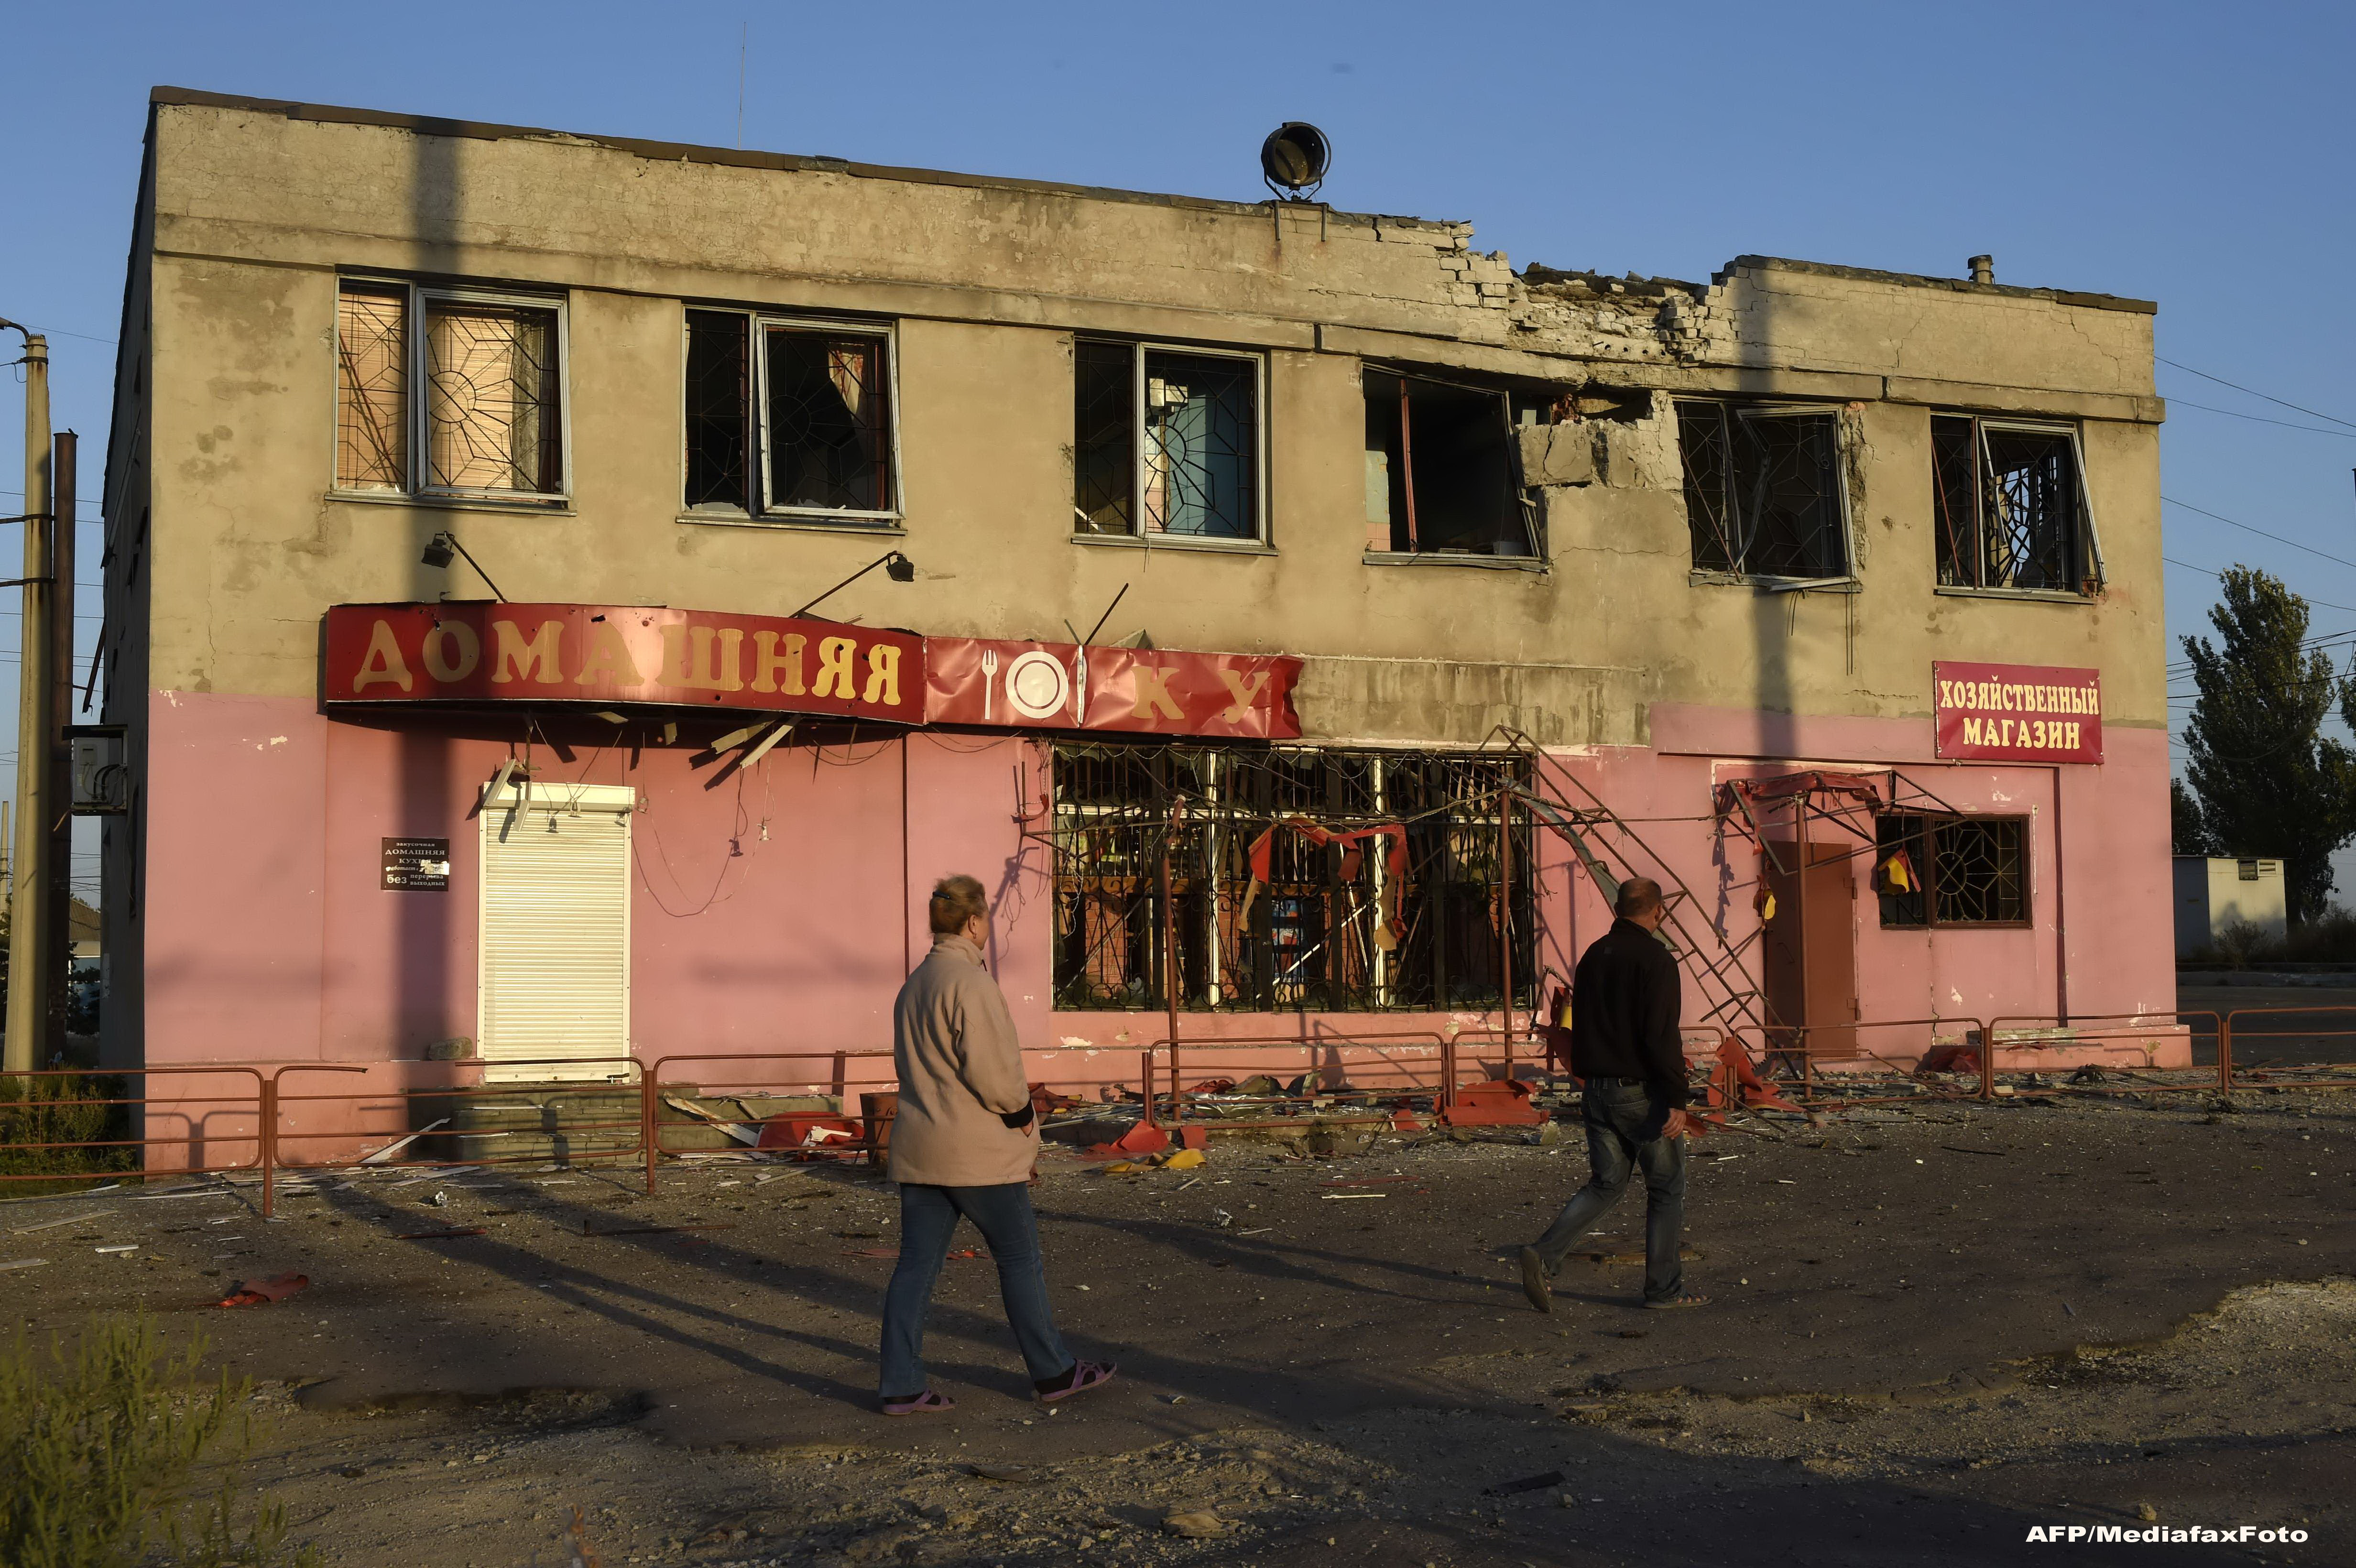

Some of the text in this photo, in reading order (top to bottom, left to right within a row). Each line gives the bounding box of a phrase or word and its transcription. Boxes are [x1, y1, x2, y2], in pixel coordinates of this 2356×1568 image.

[354, 620, 901, 705] ДОМАШНЯЯ
[1940, 675, 2099, 715] ХОЗЯЙСТВЕННЫЙ
[1963, 718, 2080, 749] МАГАЗИН
[387, 874, 407, 883] без
